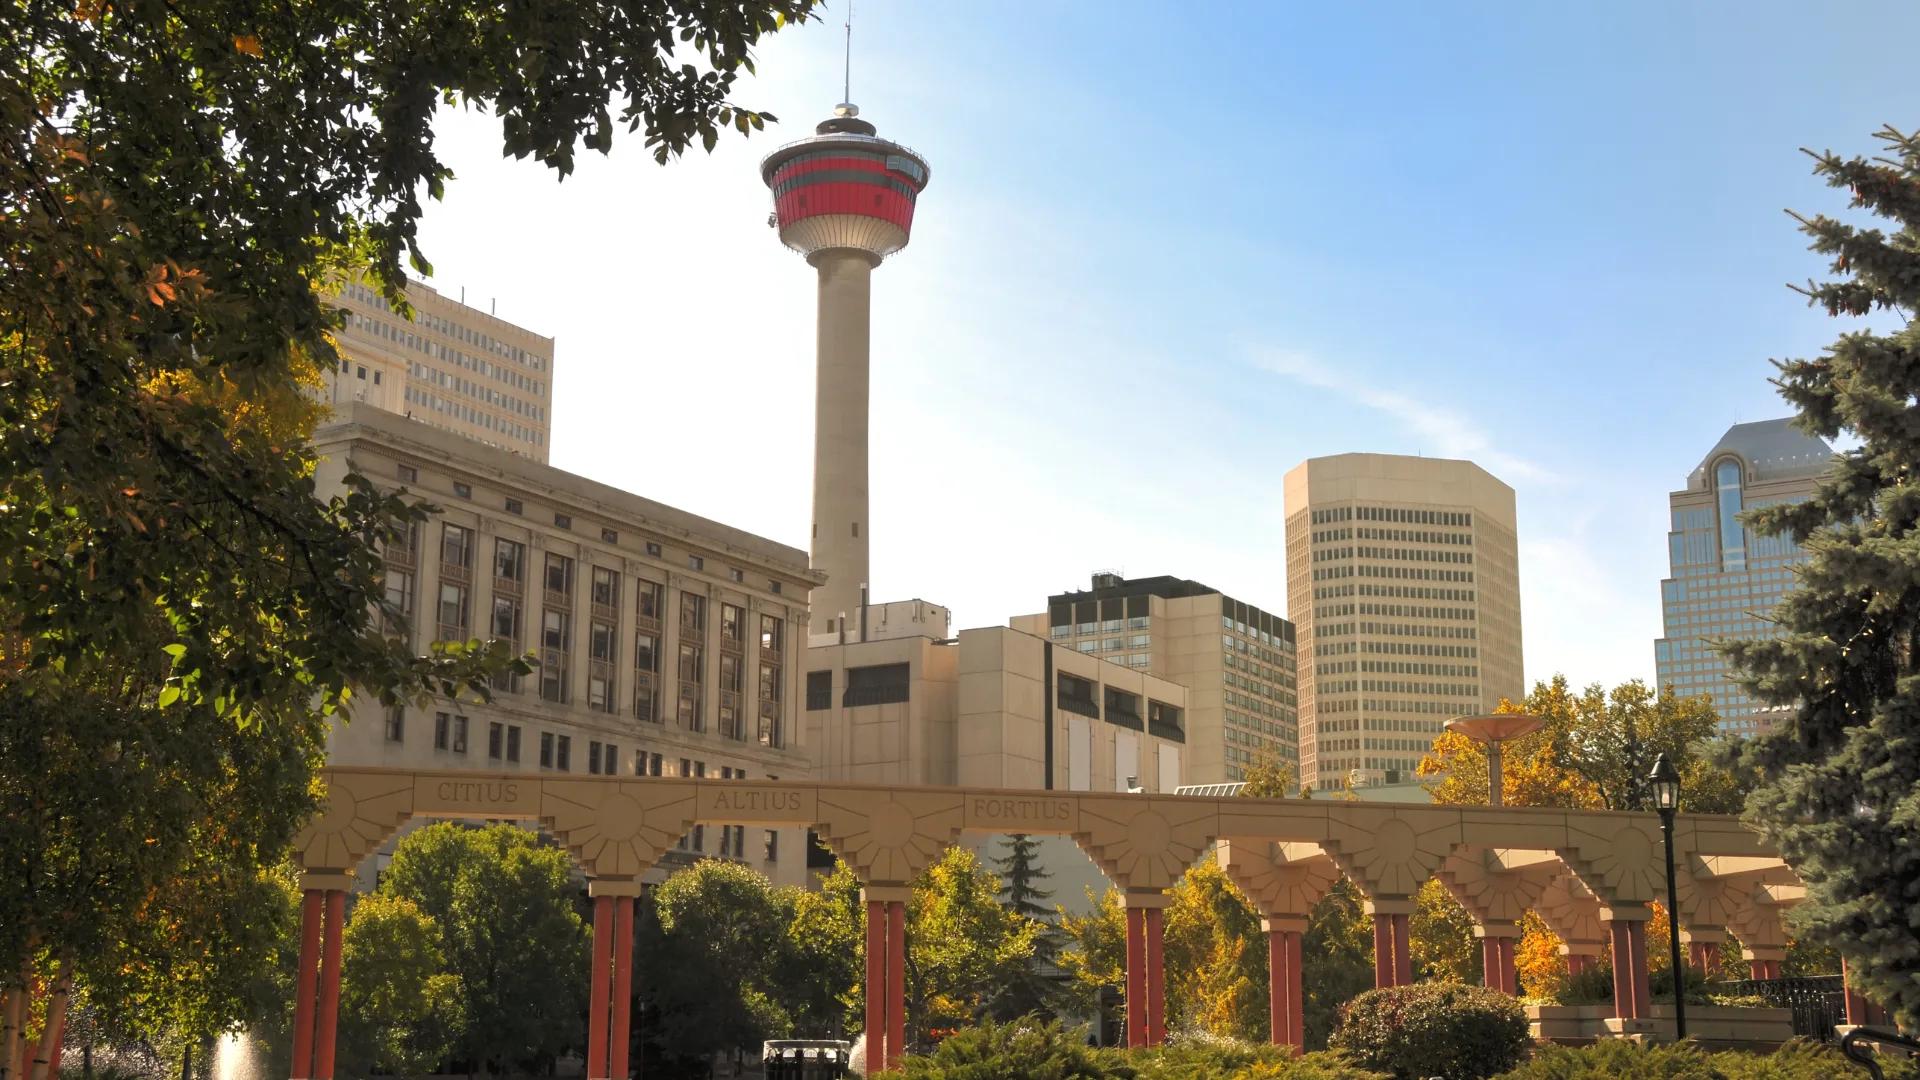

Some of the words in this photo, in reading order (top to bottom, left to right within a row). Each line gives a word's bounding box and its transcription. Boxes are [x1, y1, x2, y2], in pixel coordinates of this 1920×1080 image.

[438, 782, 518, 802] CITIUS
[713, 791, 801, 810] ALTIUS
[974, 799, 1070, 820] FORTIUS
